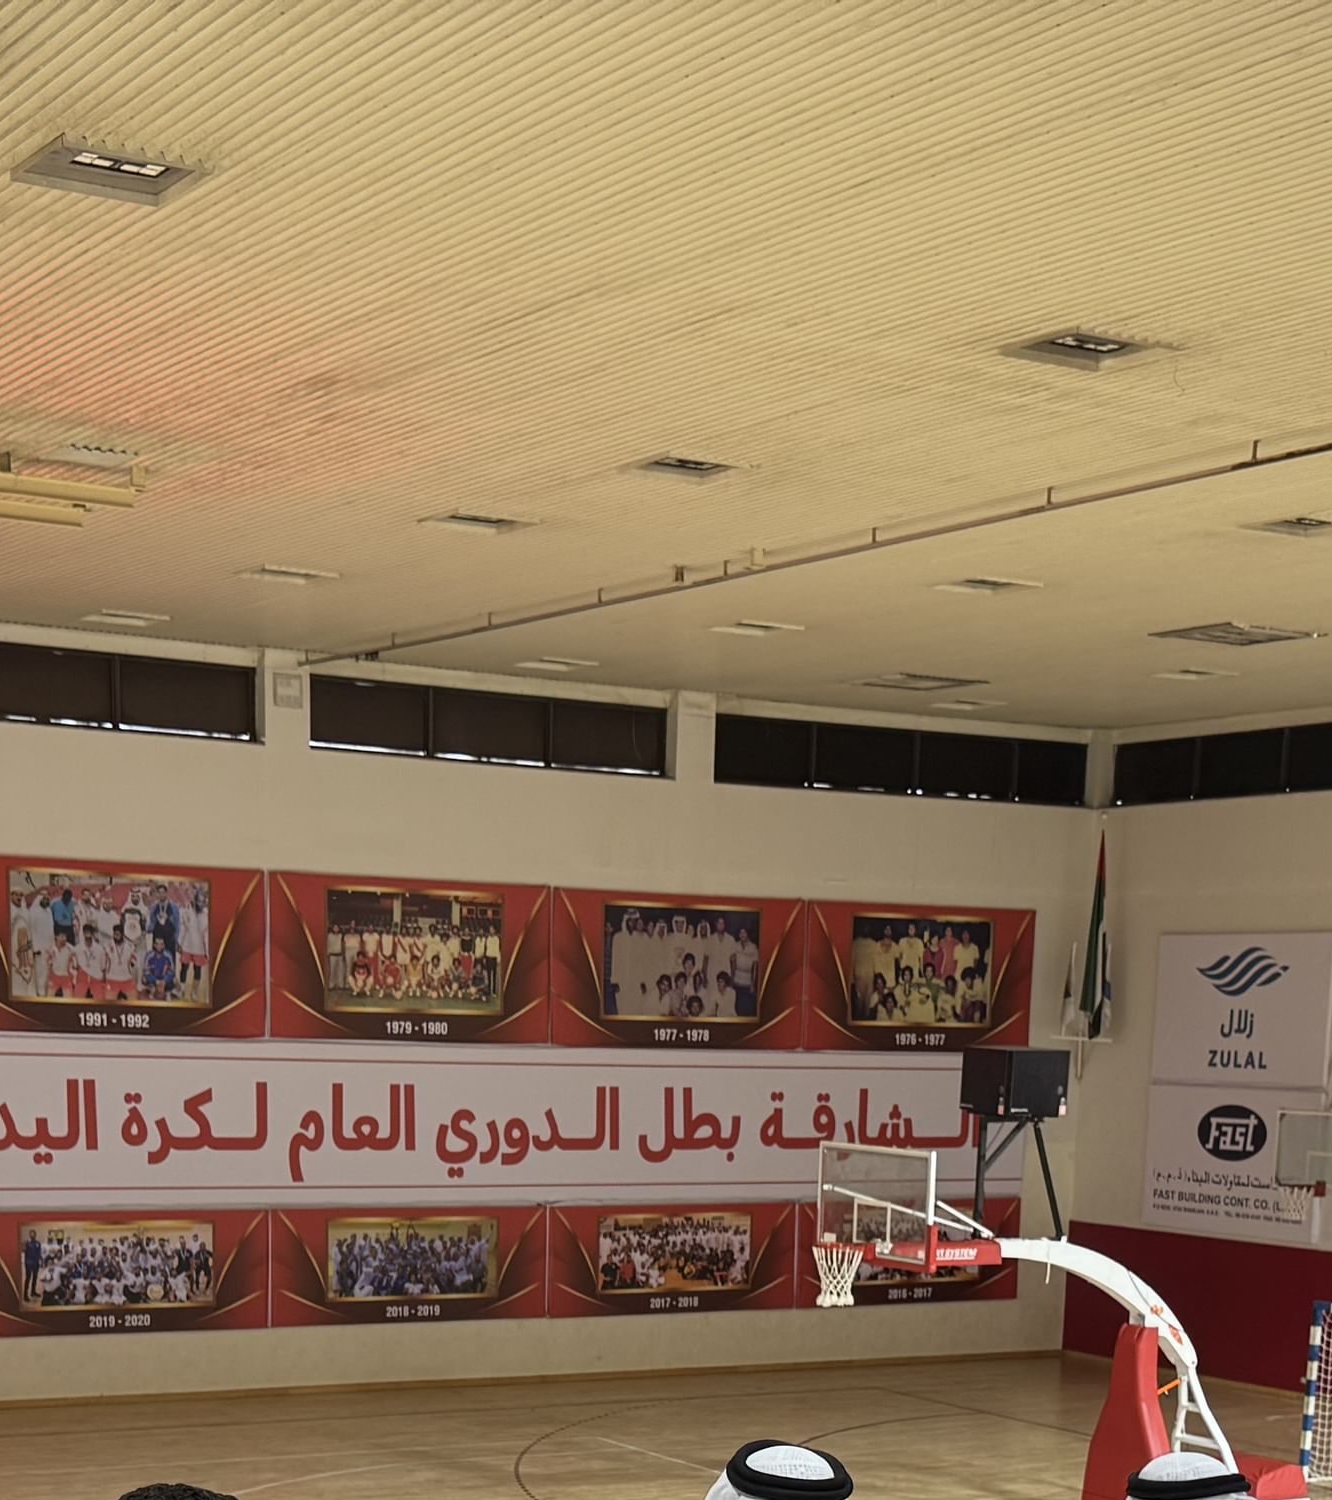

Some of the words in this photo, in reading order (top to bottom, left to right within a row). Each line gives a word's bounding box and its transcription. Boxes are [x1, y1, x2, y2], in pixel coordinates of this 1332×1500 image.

[78, 1012, 109, 1027] 1991
[120, 1013, 150, 1028] 1992
[385, 1020, 413, 1035] 1979
[421, 1021, 448, 1036] 1980
[1220, 1008, 1255, 1038] زلال
[653, 1028, 678, 1041] 1977
[686, 1029, 710, 1042] 1978
[895, 1032, 916, 1046] 1976
[924, 1033, 946, 1046] 1977
[1208, 1049, 1267, 1069] ZULAL
[120, 1081, 267, 1164] لكرة
[639, 1087, 742, 1164] بطل
[288, 1083, 415, 1182] العام
[435, 1086, 620, 1179] الدوري
[1152, 1188, 1175, 1201] FAST
[1177, 1191, 1221, 1205] BUILDING
[649, 1297, 671, 1309] 2017
[678, 1295, 699, 1308] 2018
[385, 1305, 409, 1318] 2018
[417, 1304, 441, 1317] 2019
[88, 1315, 116, 1328] 2019
[124, 1314, 151, 1327] 2020
